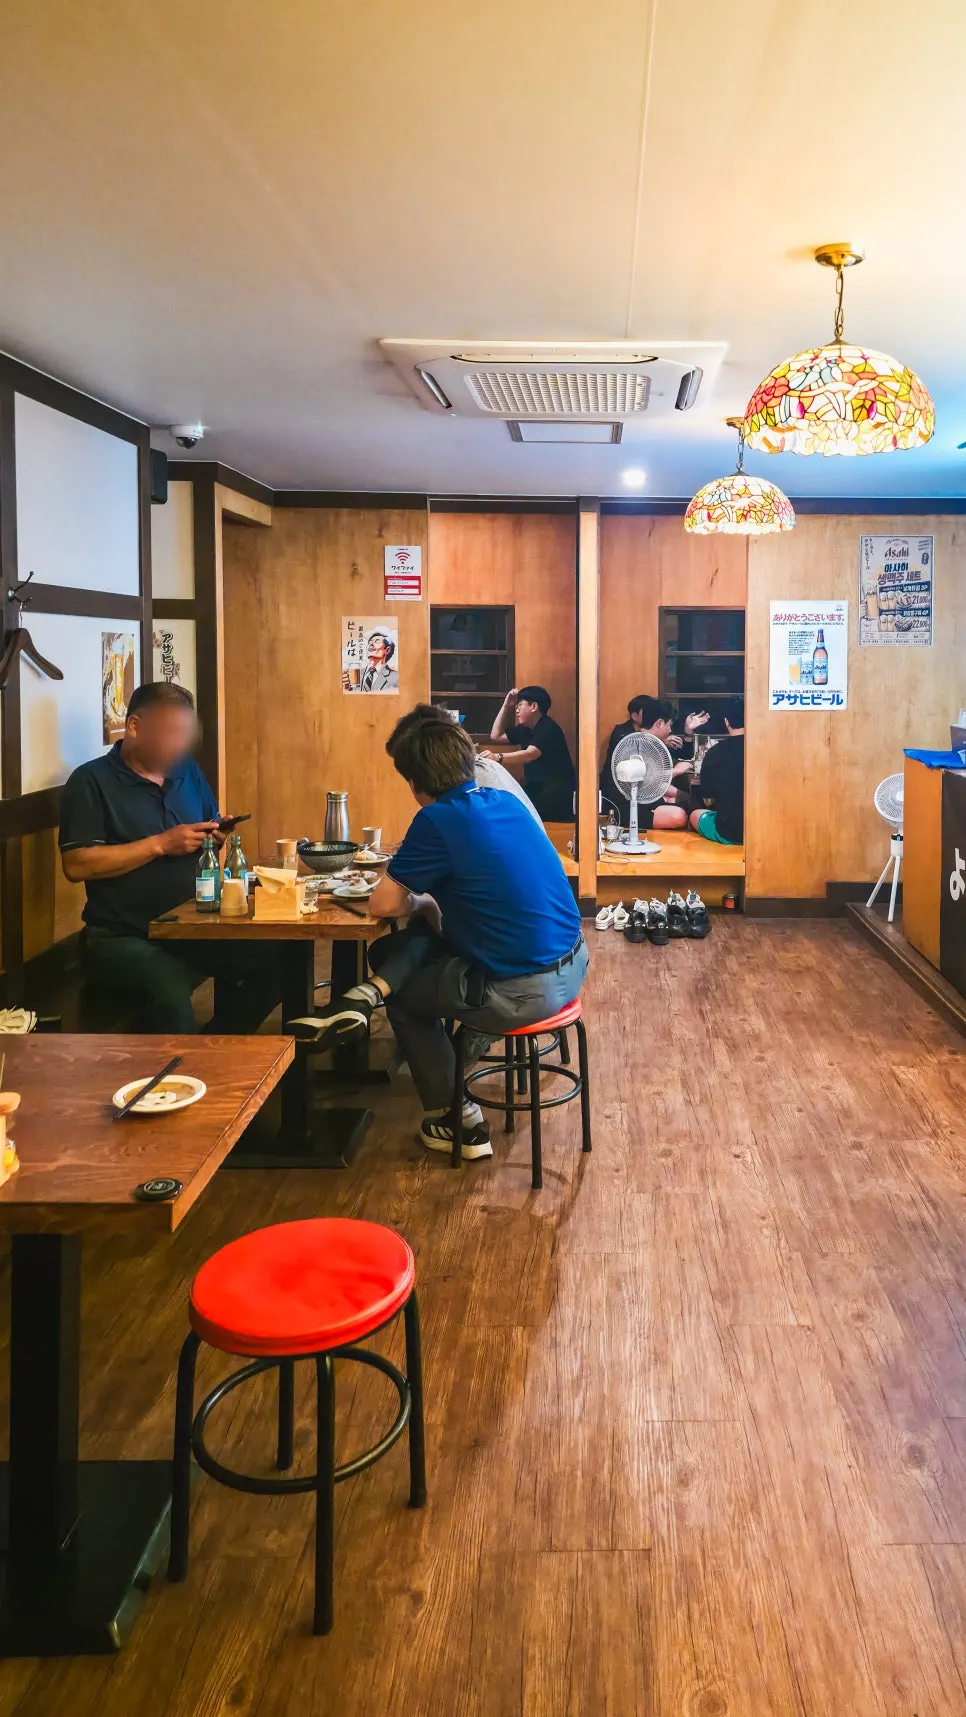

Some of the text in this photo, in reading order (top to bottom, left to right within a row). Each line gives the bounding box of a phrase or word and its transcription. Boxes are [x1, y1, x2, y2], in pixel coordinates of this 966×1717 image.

[884, 547, 909, 558] Asahi
[884, 562, 909, 573] 아사히
[877, 570, 922, 586] 생맥주 세트
[772, 613, 845, 622] ありがとうございます。
[346, 620, 357, 657] ビールは
[772, 693, 844, 706] アサヒビール
